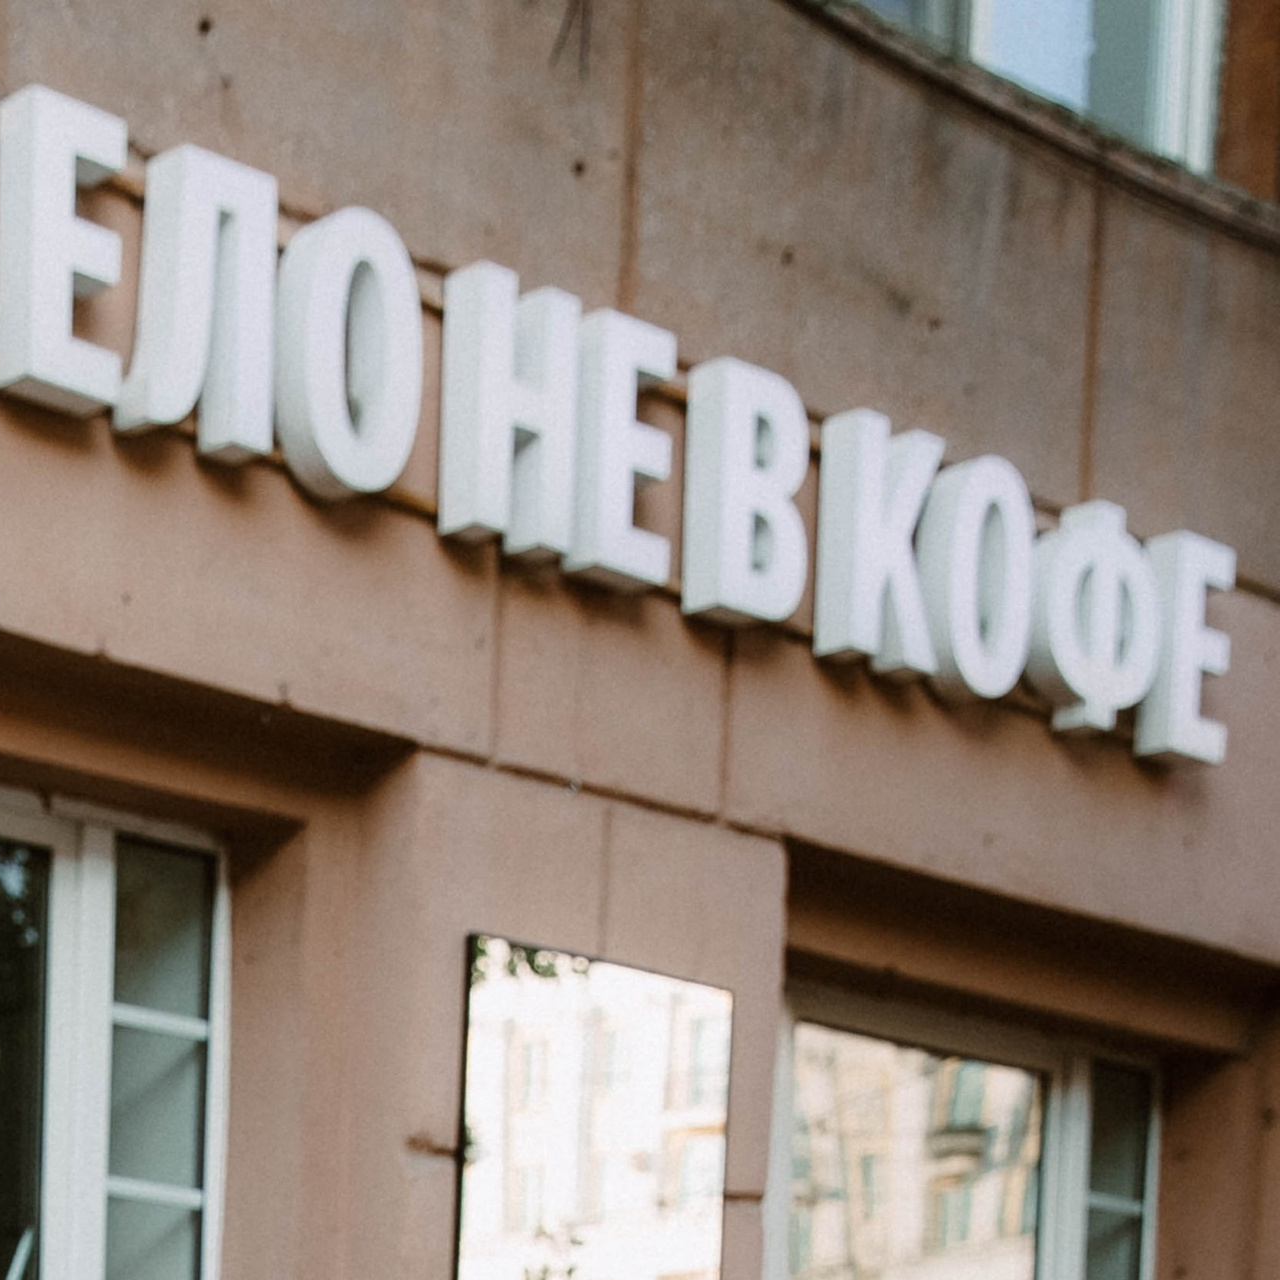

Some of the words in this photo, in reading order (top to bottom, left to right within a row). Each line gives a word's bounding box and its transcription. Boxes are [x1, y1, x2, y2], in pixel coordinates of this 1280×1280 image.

[437, 258, 678, 593] НЕ
[680, 356, 810, 629] В
[813, 407, 1238, 765] КОФЕ
